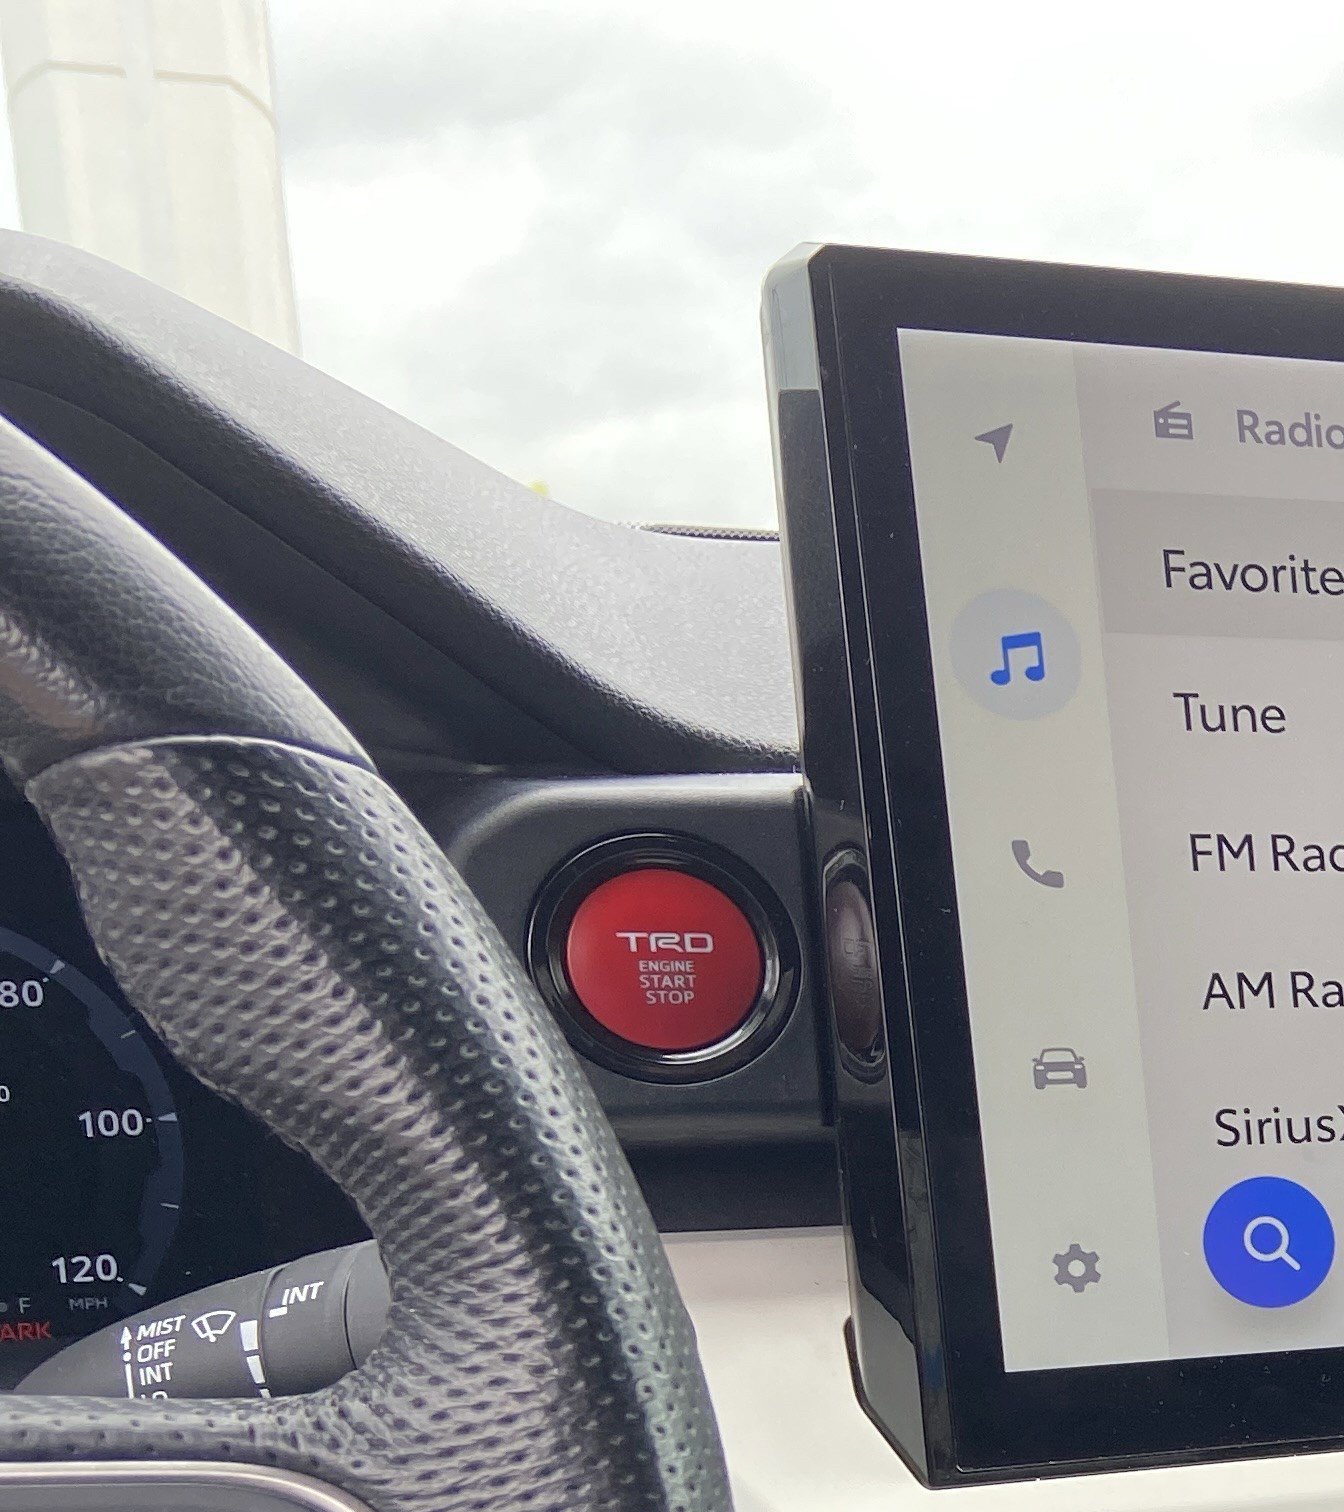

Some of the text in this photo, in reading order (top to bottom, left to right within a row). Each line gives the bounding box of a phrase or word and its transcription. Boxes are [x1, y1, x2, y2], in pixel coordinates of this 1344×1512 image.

[1173, 691, 1287, 734] Tune
[1189, 833, 1256, 873] FM
[615, 931, 715, 953] TRD
[638, 960, 695, 973] ENGINE
[0, 980, 44, 1008] 80
[640, 974, 697, 989] START
[1202, 970, 1275, 1010] AM
[646, 990, 695, 1005] STOP
[78, 1109, 144, 1138] 100
[52, 1254, 118, 1284] 120
[69, 1297, 108, 1311] MPH
[282, 1281, 324, 1306] INT
[0, 1321, 52, 1340] ARK
[136, 1314, 187, 1341] MIST
[137, 1338, 176, 1363] OFF
[139, 1362, 173, 1386] INT
